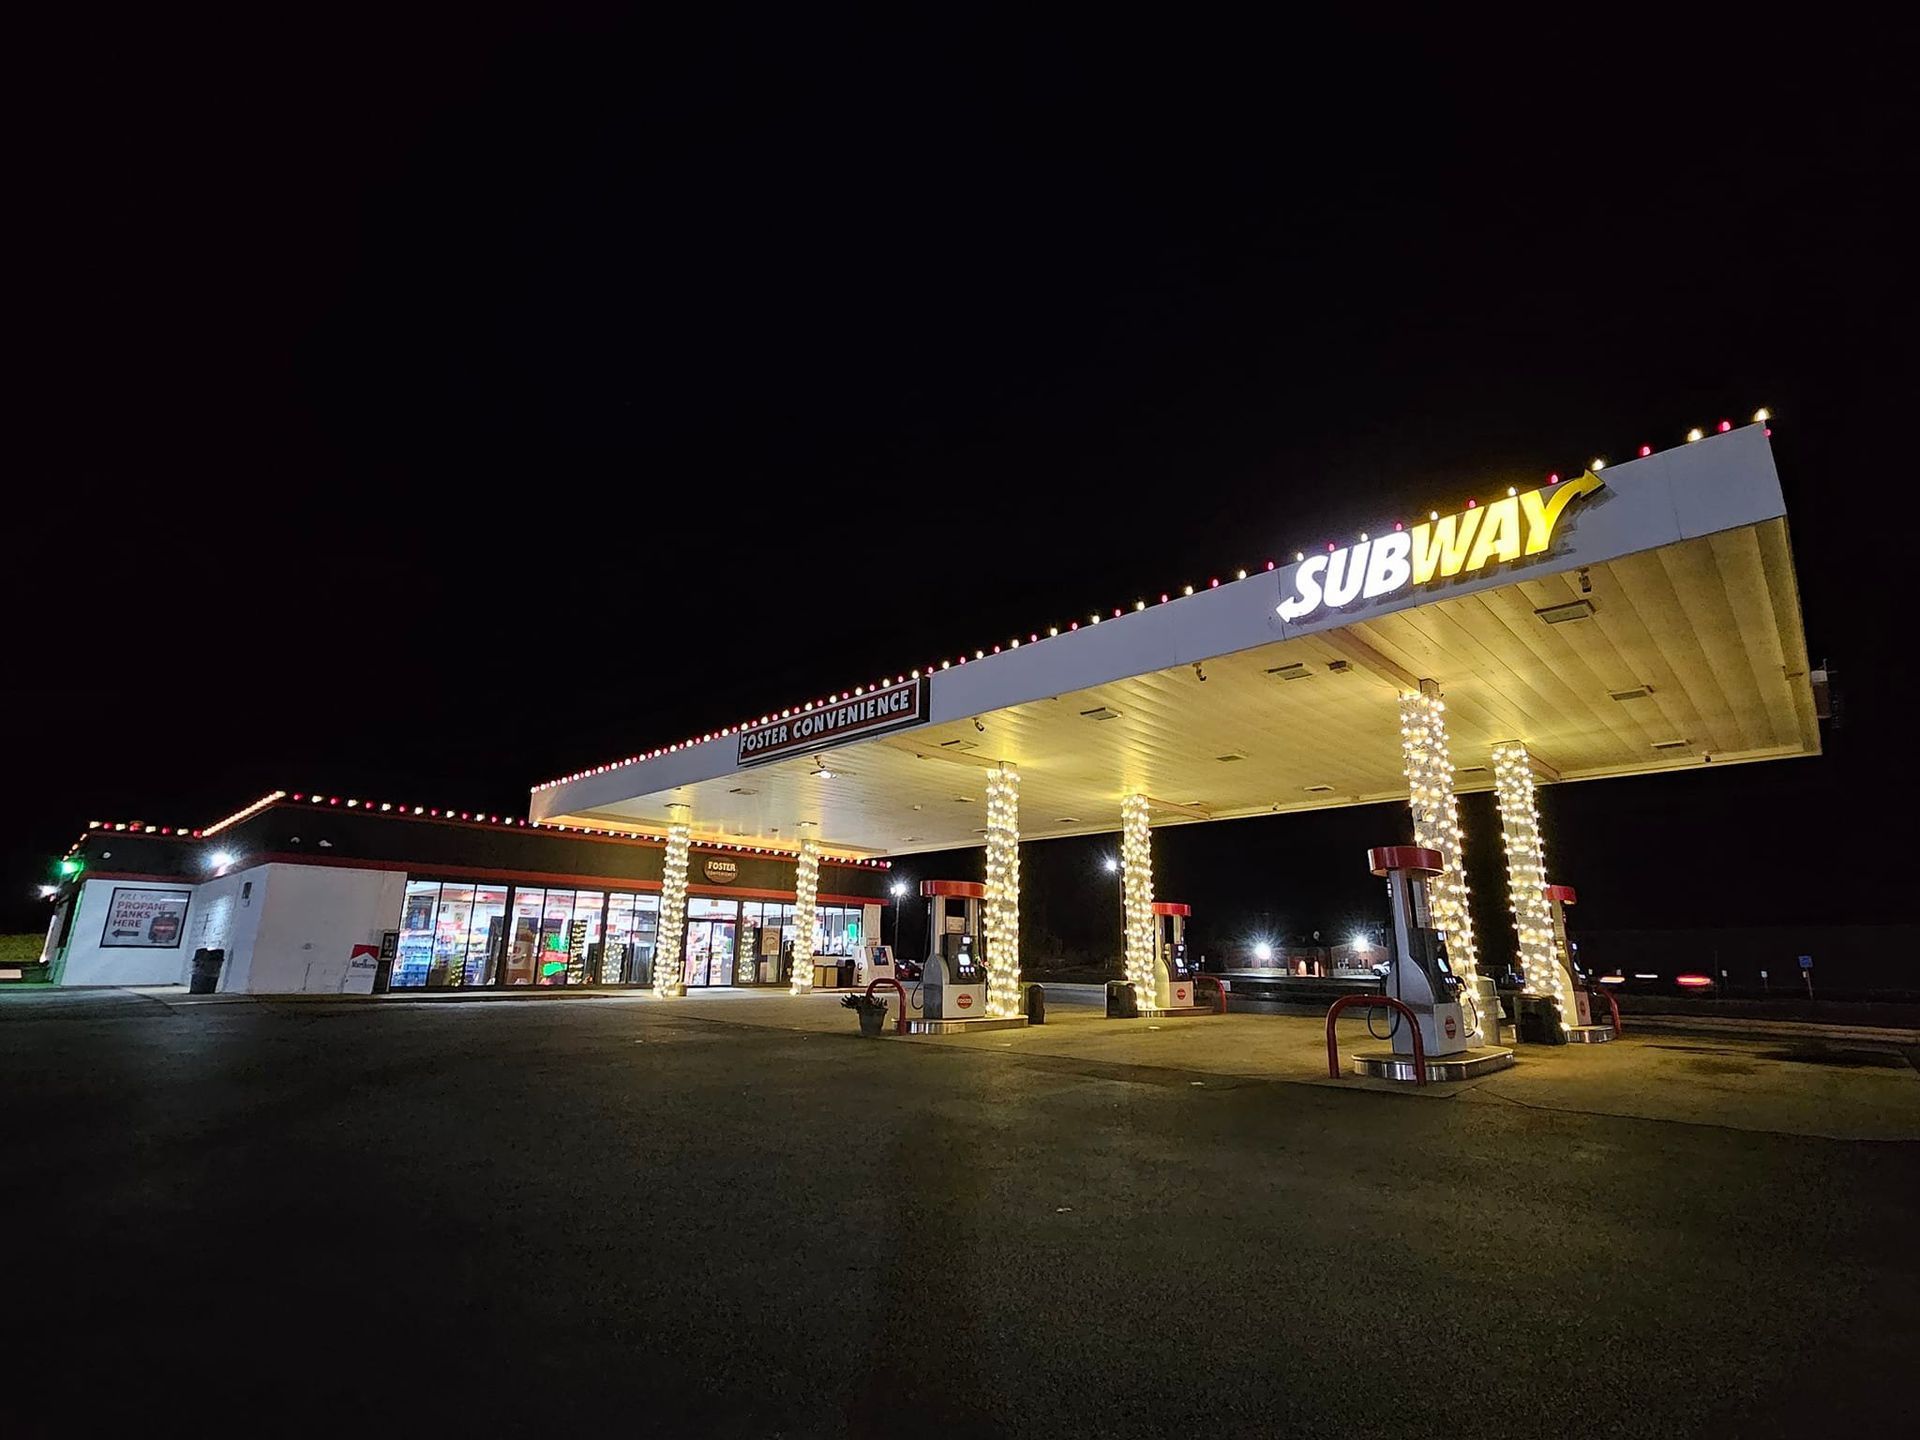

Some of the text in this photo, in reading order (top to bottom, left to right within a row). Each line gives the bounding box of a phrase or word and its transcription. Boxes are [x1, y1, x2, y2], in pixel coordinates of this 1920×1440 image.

[1276, 469, 1605, 623] SUBWAY
[740, 689, 910, 753] FOSTER CONVENIENCE
[708, 861, 736, 871] FOSTER
[116, 901, 168, 911] PROPANE
[115, 910, 151, 919] TANKS
[112, 919, 142, 928] HERE
